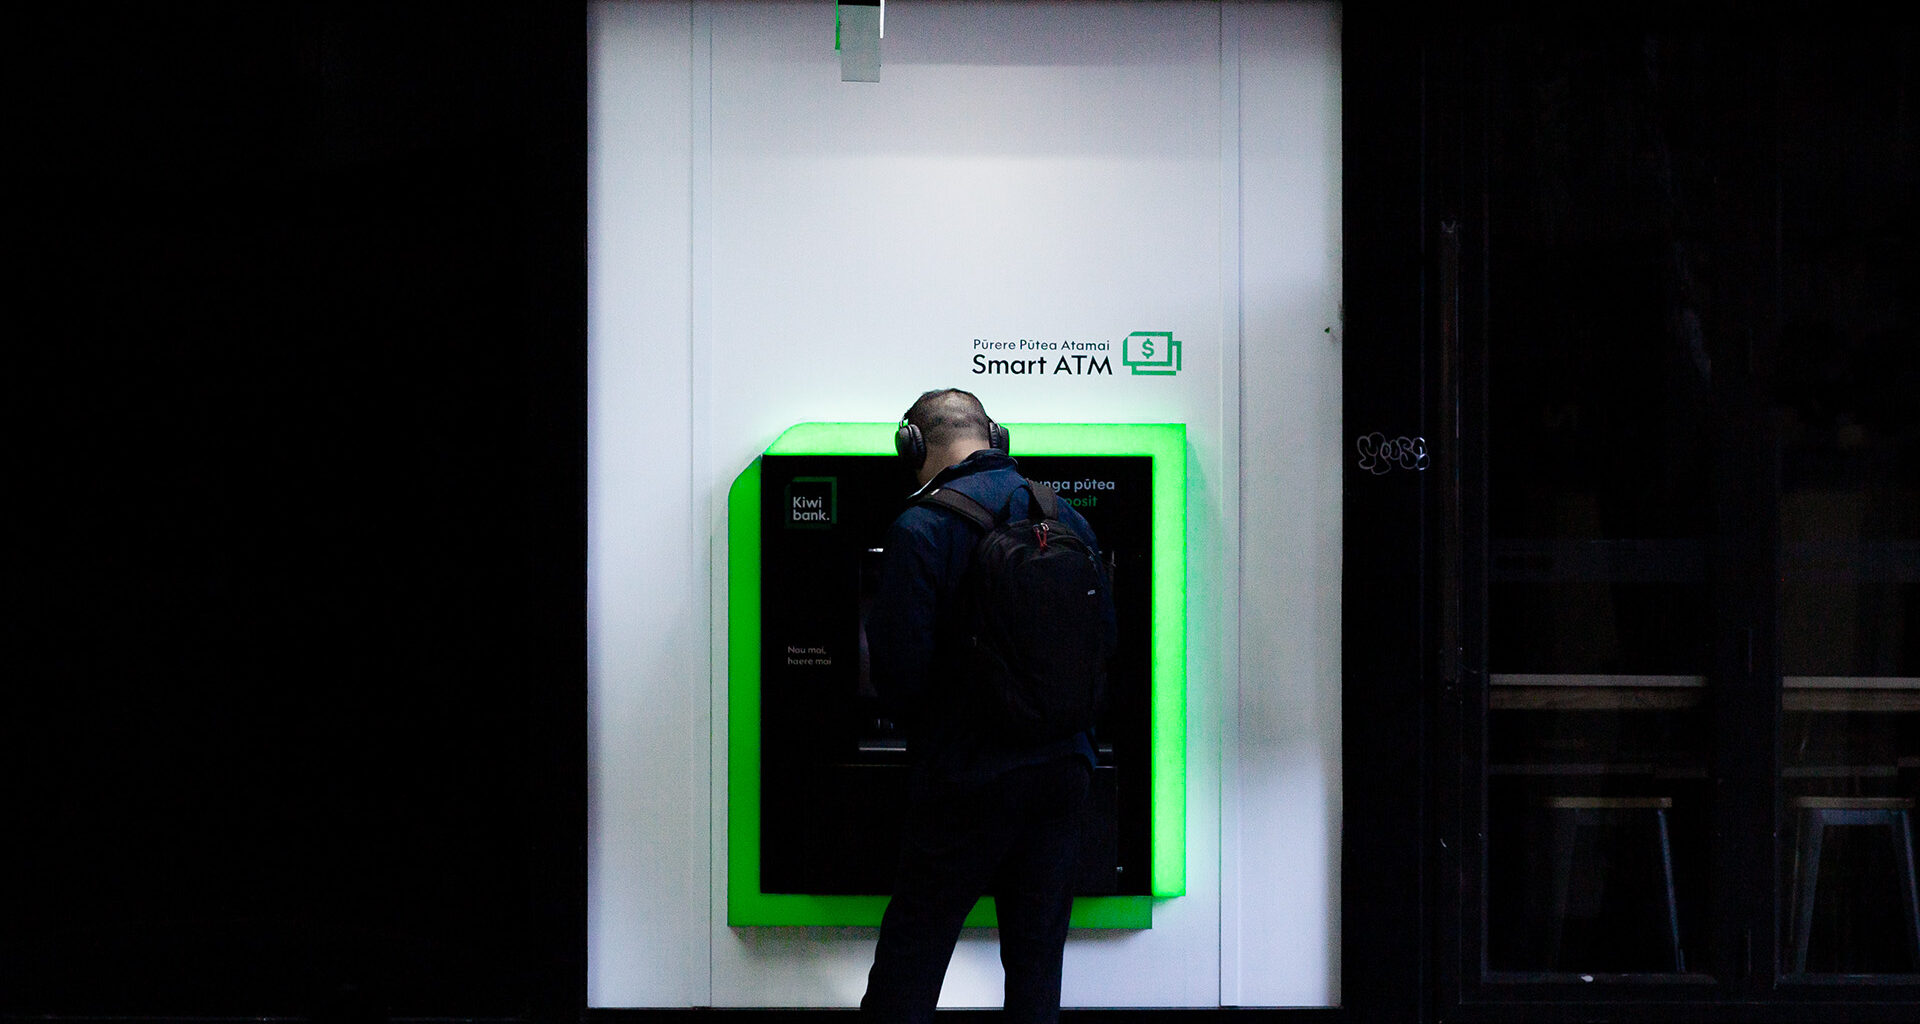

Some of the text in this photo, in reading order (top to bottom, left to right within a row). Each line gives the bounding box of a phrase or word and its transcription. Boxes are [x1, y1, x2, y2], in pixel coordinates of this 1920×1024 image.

[973, 338, 1110, 351] Pūrere Pūtea Atamai
[971, 353, 1113, 375] Smart ATM
[1040, 478, 1116, 493] nga pūtea
[792, 496, 822, 508] Kiwi
[792, 508, 830, 521] bank.
[787, 645, 806, 654] Nau
[787, 656, 832, 666] haere mai
